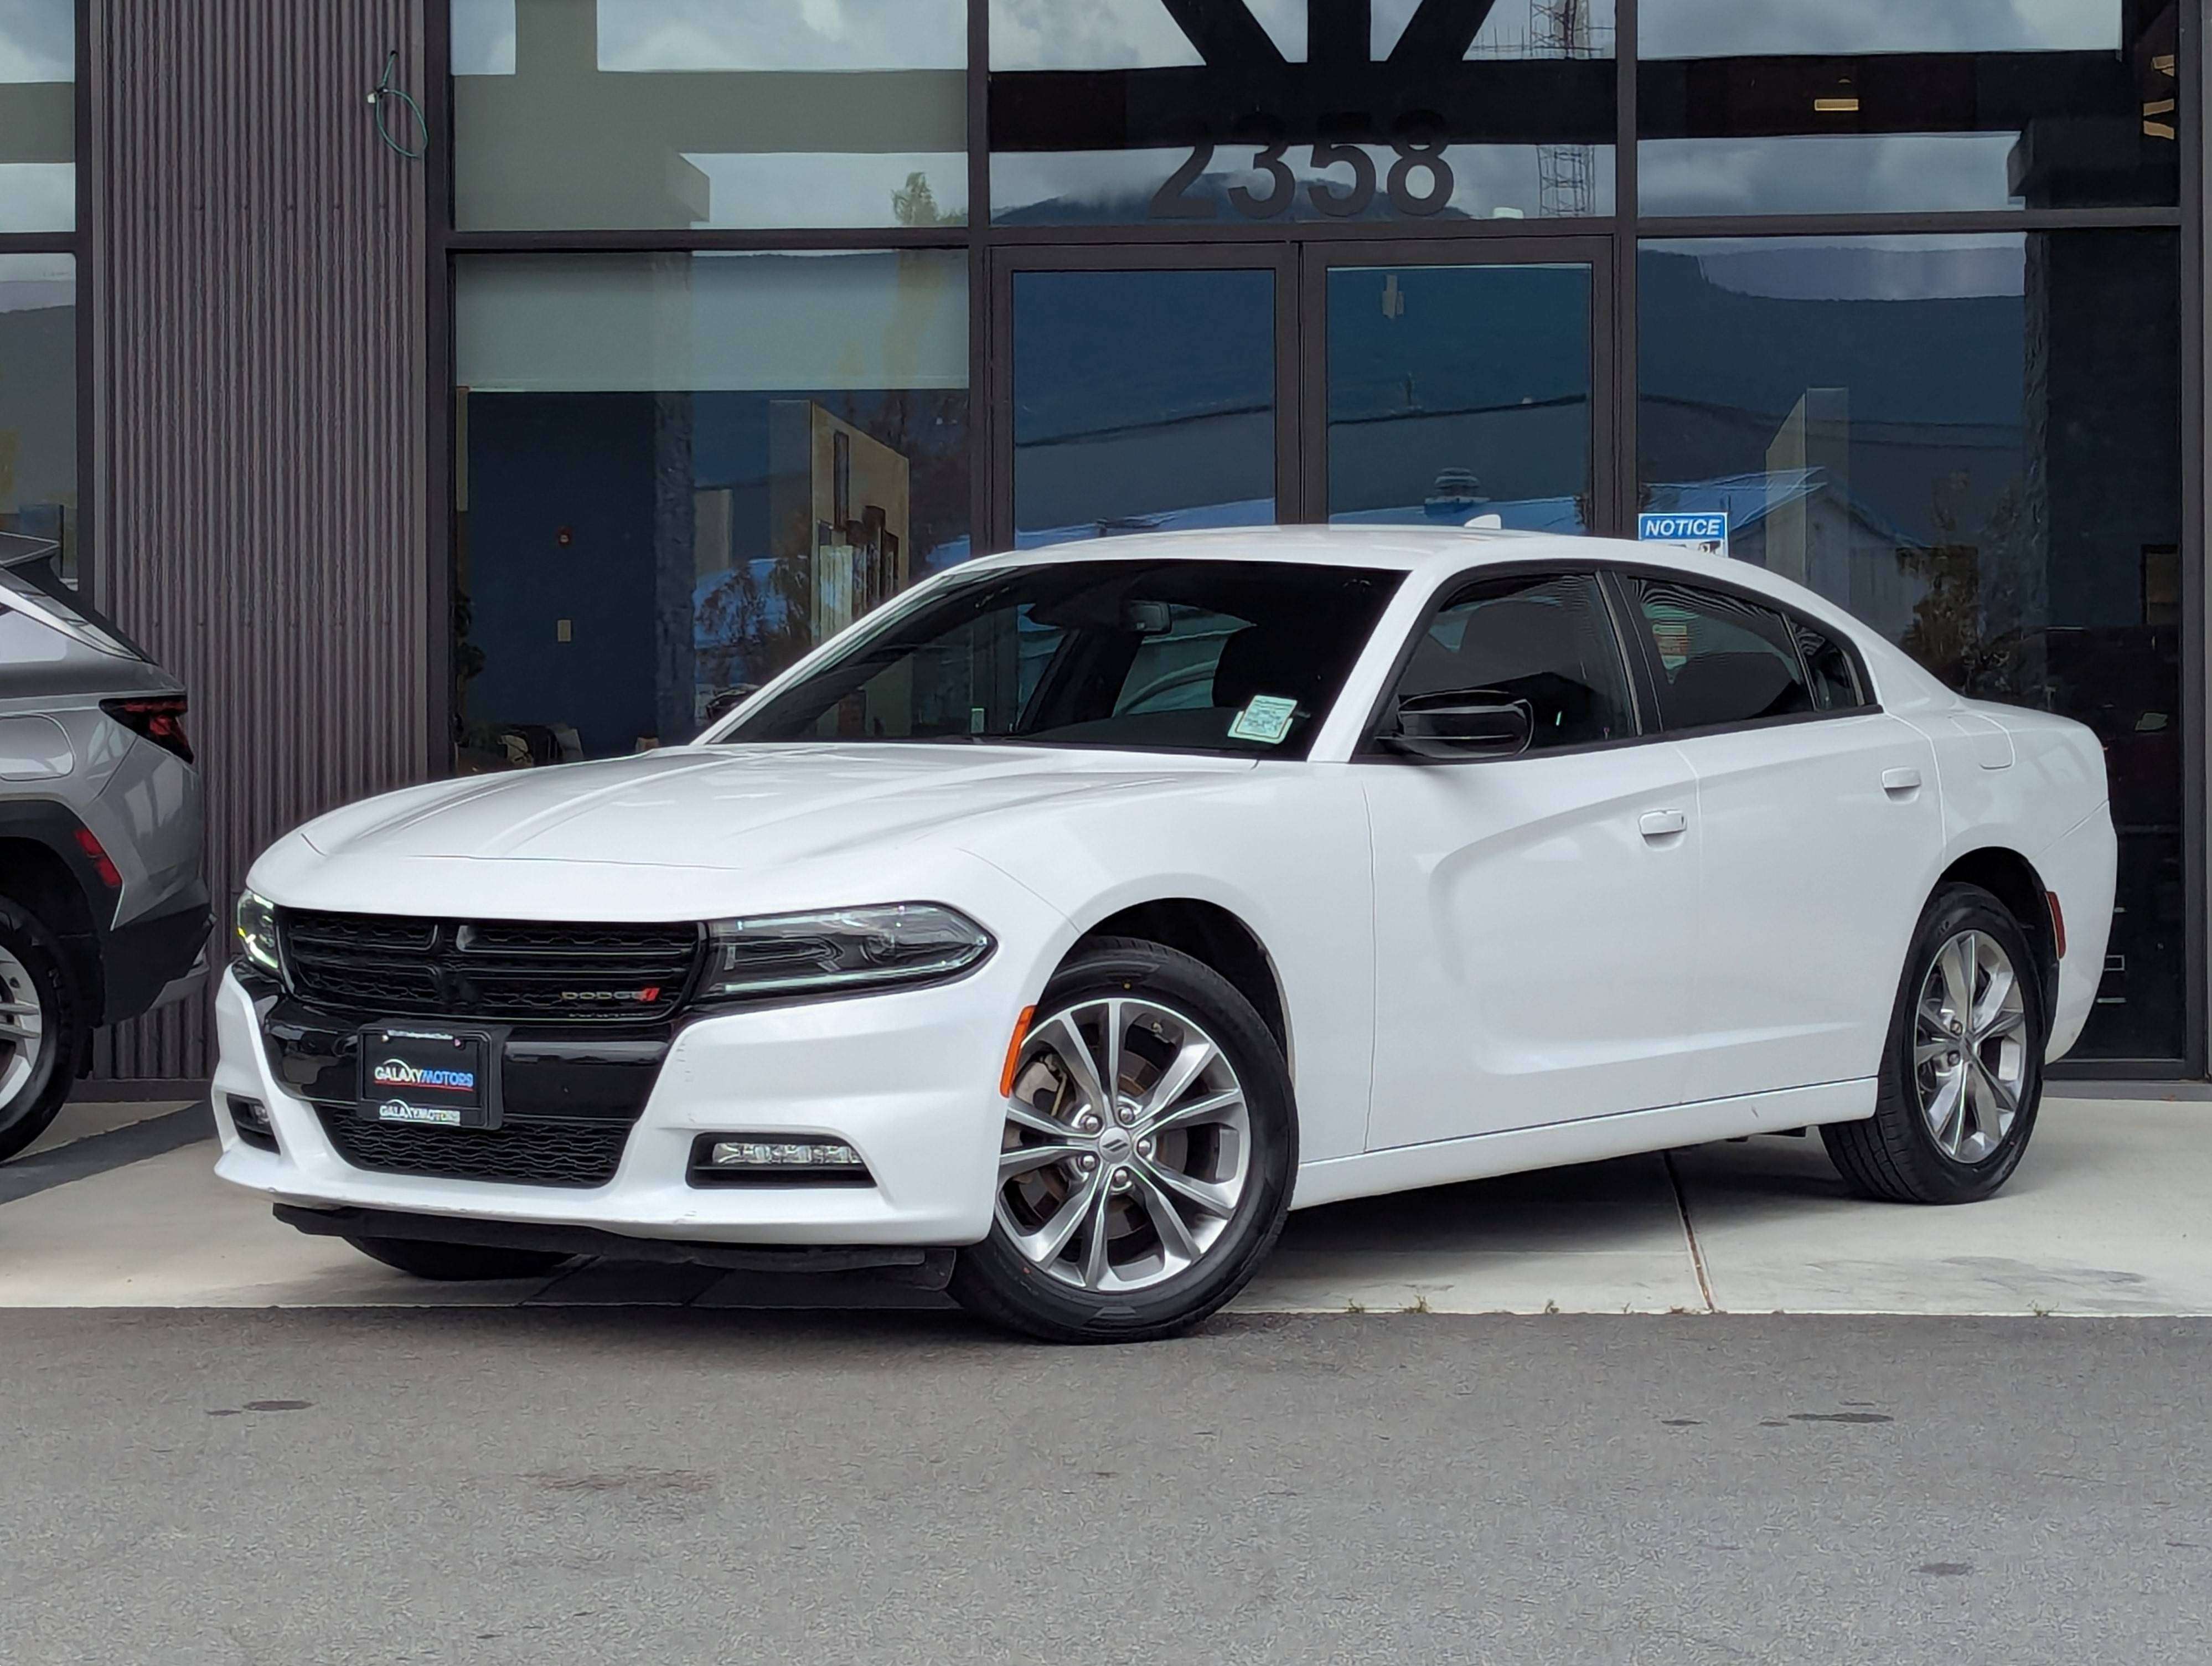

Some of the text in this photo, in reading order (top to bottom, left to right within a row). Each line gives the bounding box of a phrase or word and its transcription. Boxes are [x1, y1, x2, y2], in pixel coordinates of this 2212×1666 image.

[1150, 111, 1454, 219] 2358
[1645, 519, 1722, 537] NOTICE
[561, 991, 647, 1000] DODGE
